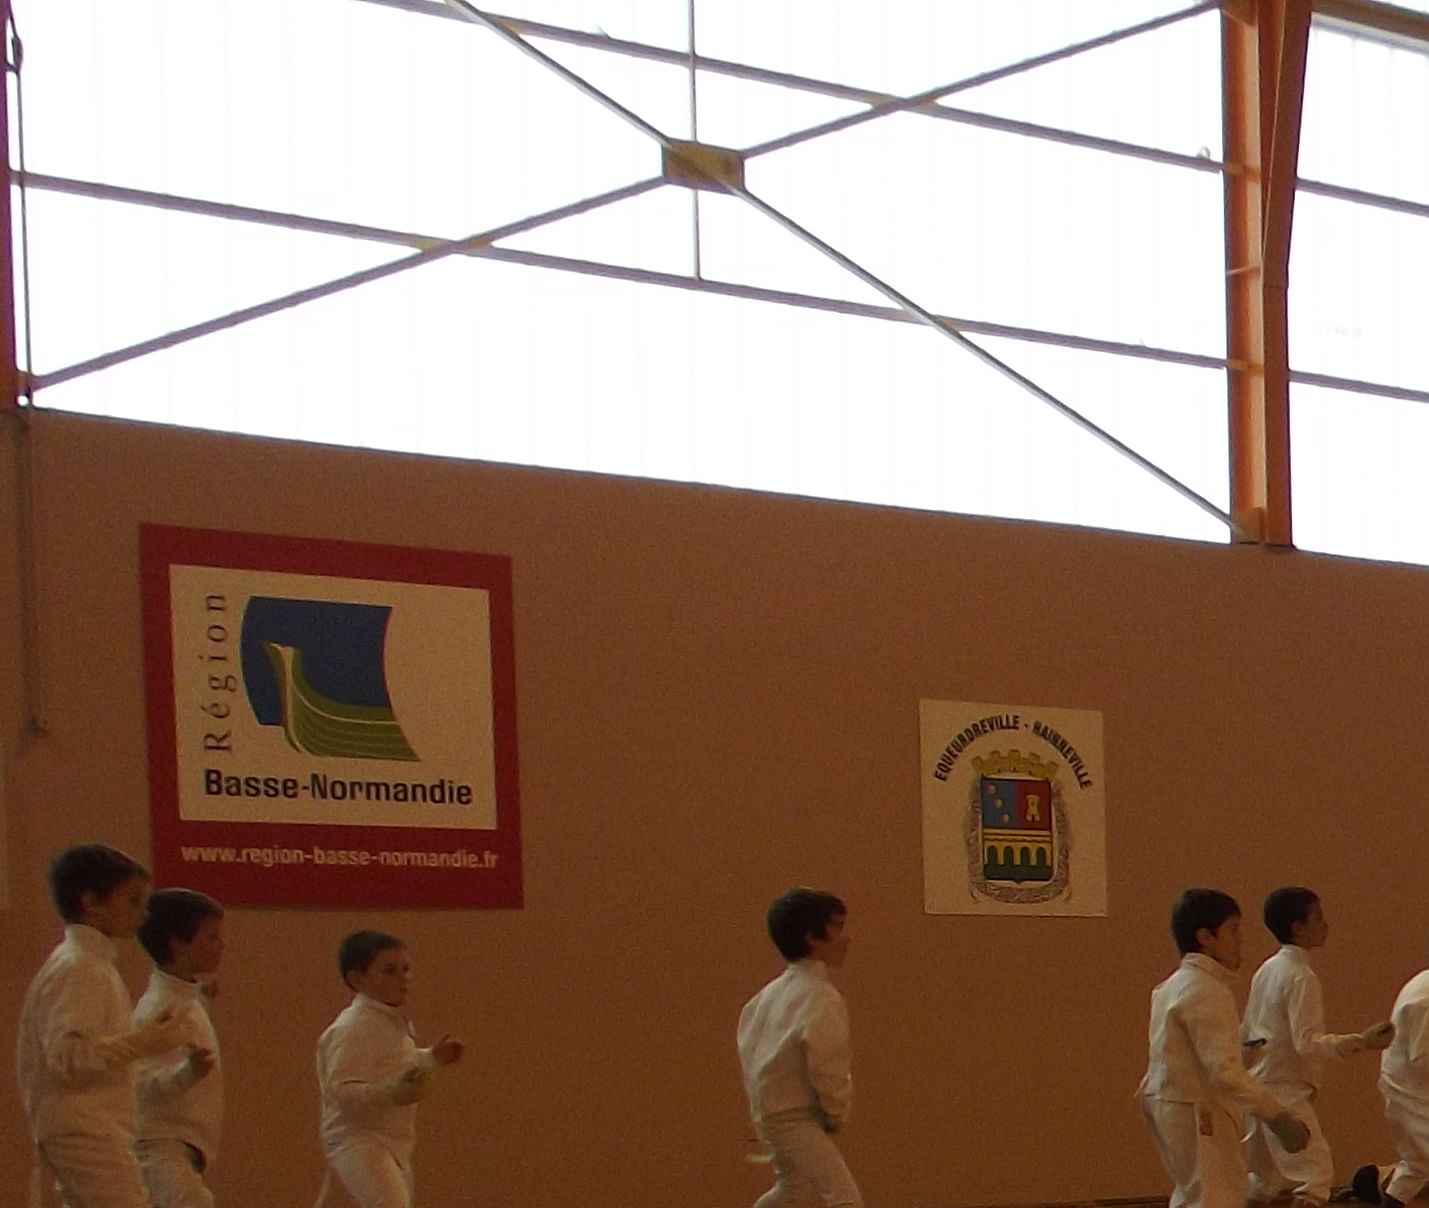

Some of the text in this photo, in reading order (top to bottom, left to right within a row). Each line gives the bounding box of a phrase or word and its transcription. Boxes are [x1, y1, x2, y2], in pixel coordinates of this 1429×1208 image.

[199, 593, 237, 753] Région
[204, 769, 473, 804] Basse-Normandie
[181, 845, 499, 870] www.region-basse-normandie.fr
